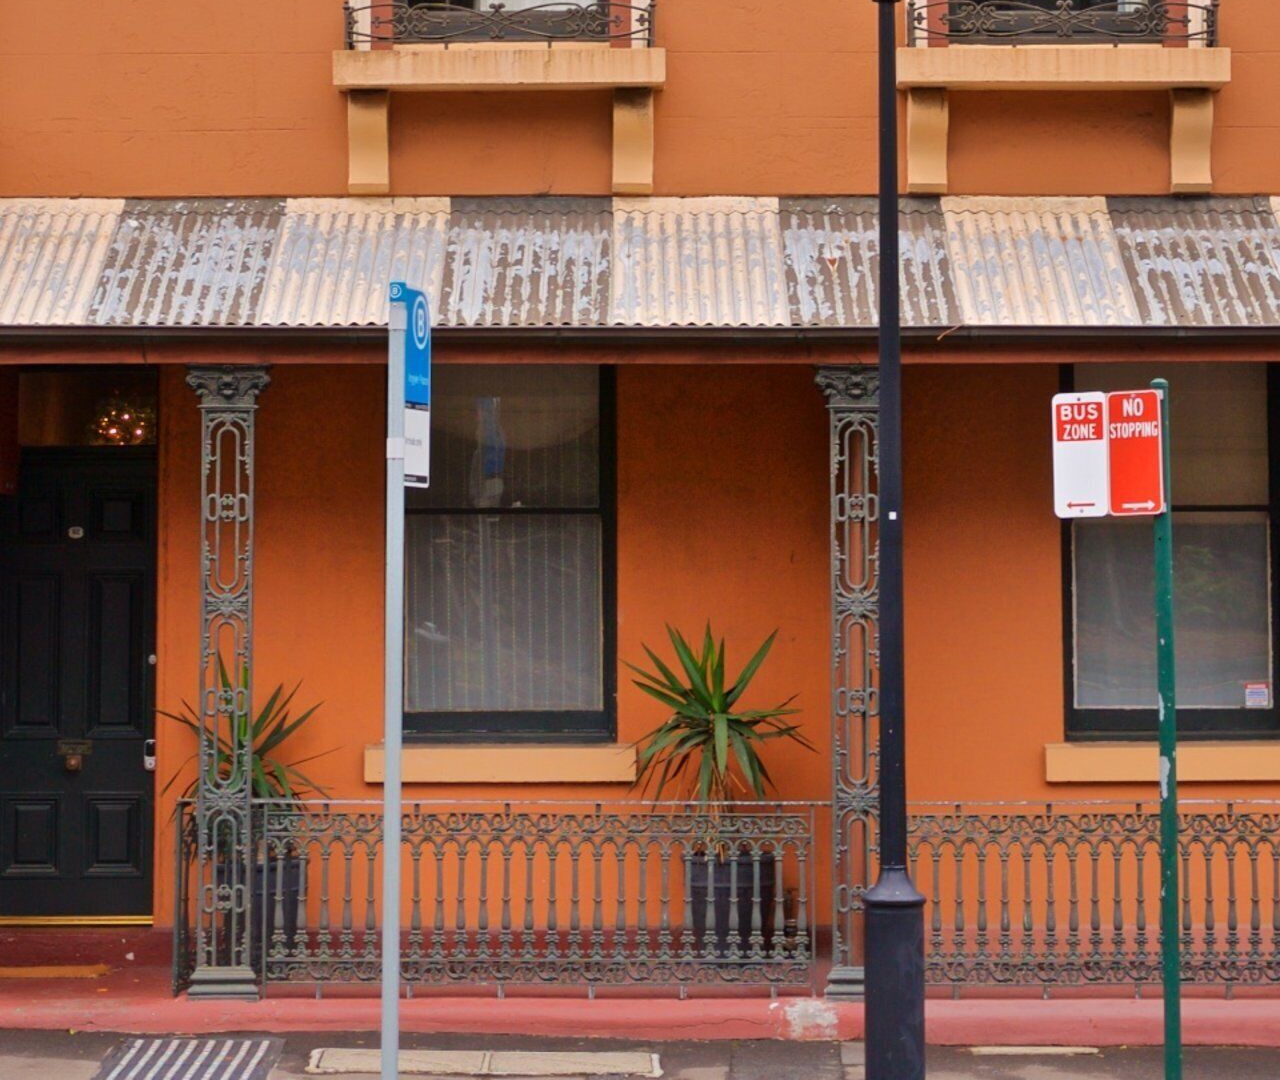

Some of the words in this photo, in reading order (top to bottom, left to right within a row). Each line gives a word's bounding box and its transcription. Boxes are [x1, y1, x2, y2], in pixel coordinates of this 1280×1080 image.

[1060, 404, 1099, 421] BUS
[1122, 398, 1144, 418] NO
[1063, 423, 1097, 440] ZONE
[1109, 421, 1158, 439] STOPPING
